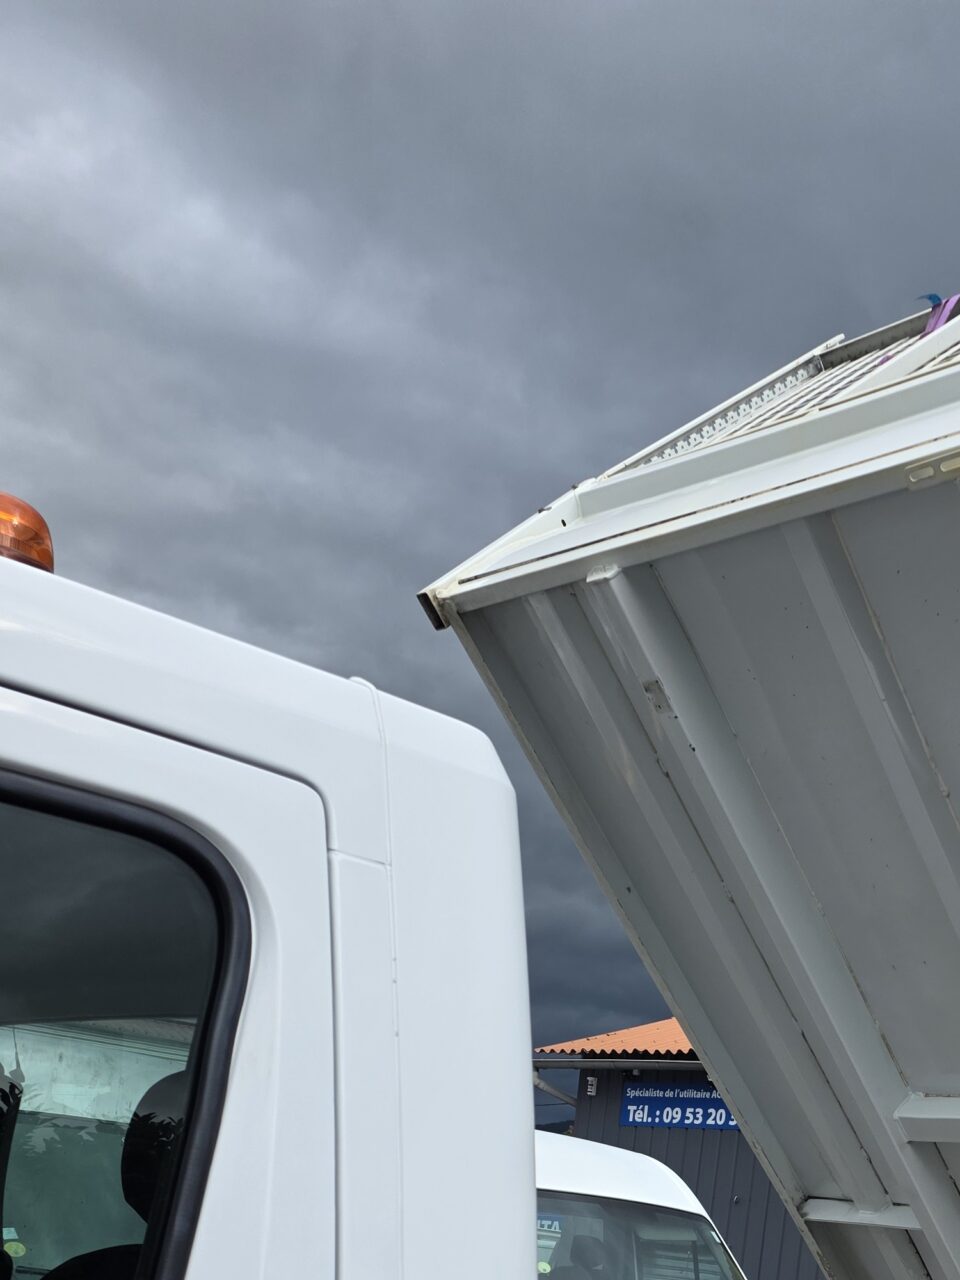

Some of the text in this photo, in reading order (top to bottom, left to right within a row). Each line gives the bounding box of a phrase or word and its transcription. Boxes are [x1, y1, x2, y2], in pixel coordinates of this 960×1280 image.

[626, 1088, 663, 1098] Spécialiste
[665, 1089, 674, 1098] de
[627, 1105, 652, 1122] Tél.
[663, 1107, 682, 1123] 09
[684, 1108, 703, 1124] 53
[706, 1108, 726, 1125] 20
